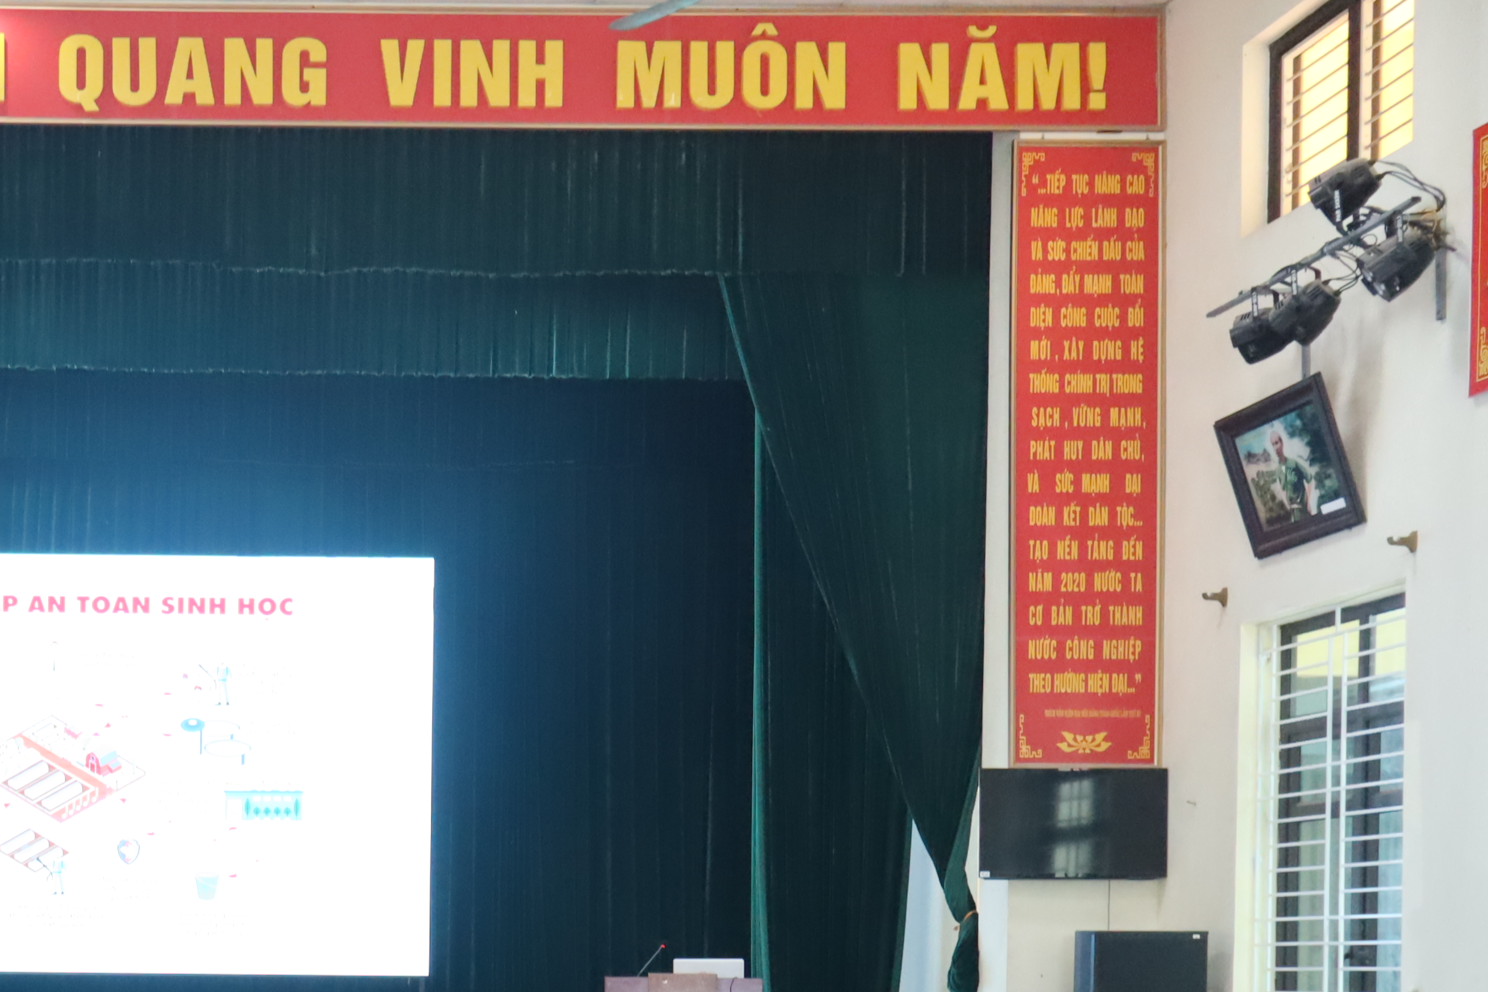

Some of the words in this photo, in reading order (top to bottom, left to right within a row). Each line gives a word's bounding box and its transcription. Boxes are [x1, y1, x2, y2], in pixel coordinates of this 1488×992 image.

[60, 34, 327, 111] QUANG
[381, 38, 563, 107] VINH
[618, 23, 846, 109] MUÔN
[899, 25, 1106, 111] NĂM!
[1126, 175, 1145, 194] CAO
[1112, 373, 1143, 394] TRONG
[1064, 440, 1083, 460] HUY
[1061, 573, 1087, 592] 2020
[1131, 573, 1143, 592] TA
[28, 595, 66, 613] AN
[162, 596, 226, 615] SINH
[1029, 673, 1052, 693] THEO
